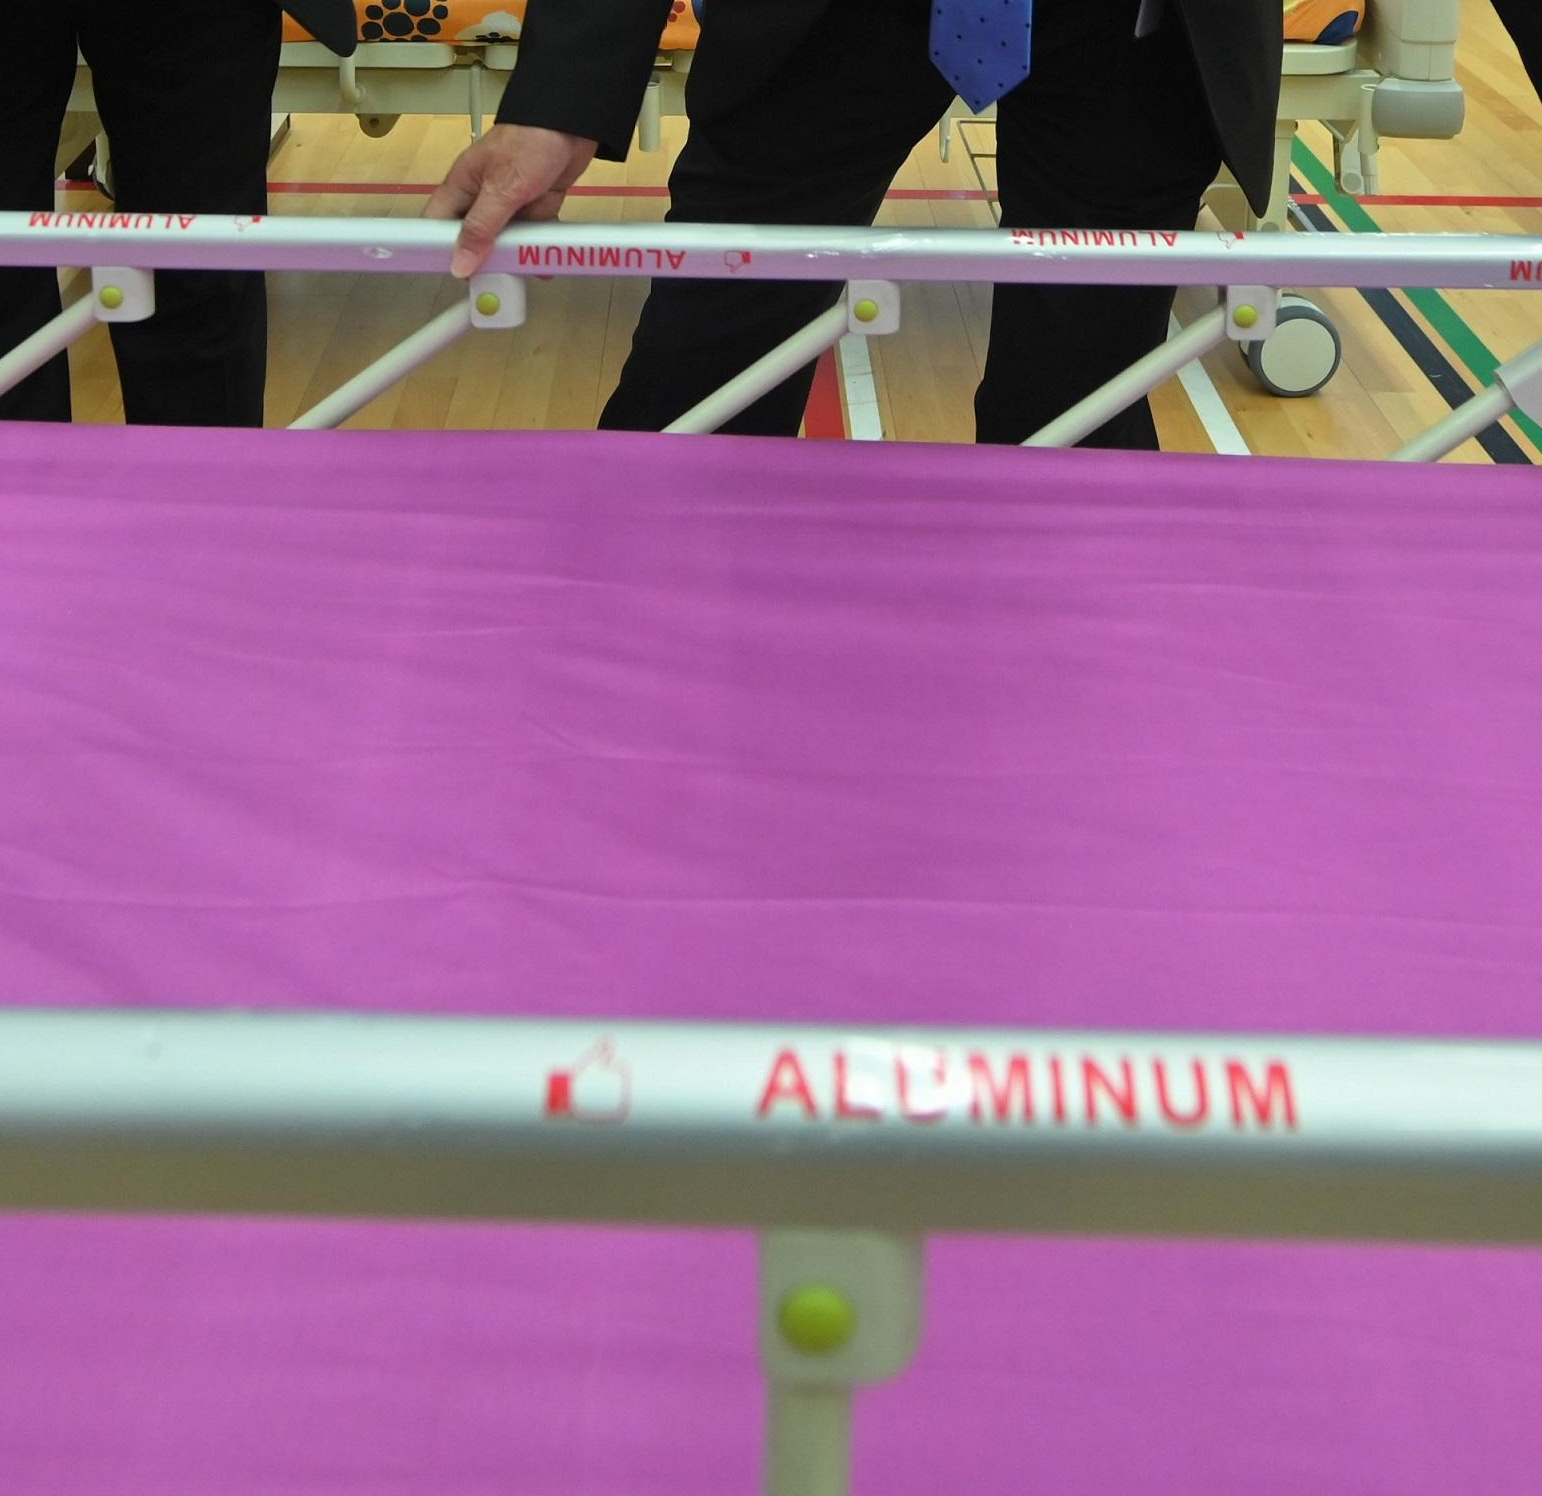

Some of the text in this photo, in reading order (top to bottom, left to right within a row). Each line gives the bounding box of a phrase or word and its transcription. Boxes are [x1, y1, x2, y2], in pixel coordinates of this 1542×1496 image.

[29, 211, 196, 230] ALUMINUM
[1011, 229, 1178, 248] ALUMINUM
[518, 244, 686, 270] ALUMINUM
[756, 1046, 1299, 1132] ALUMINUM
